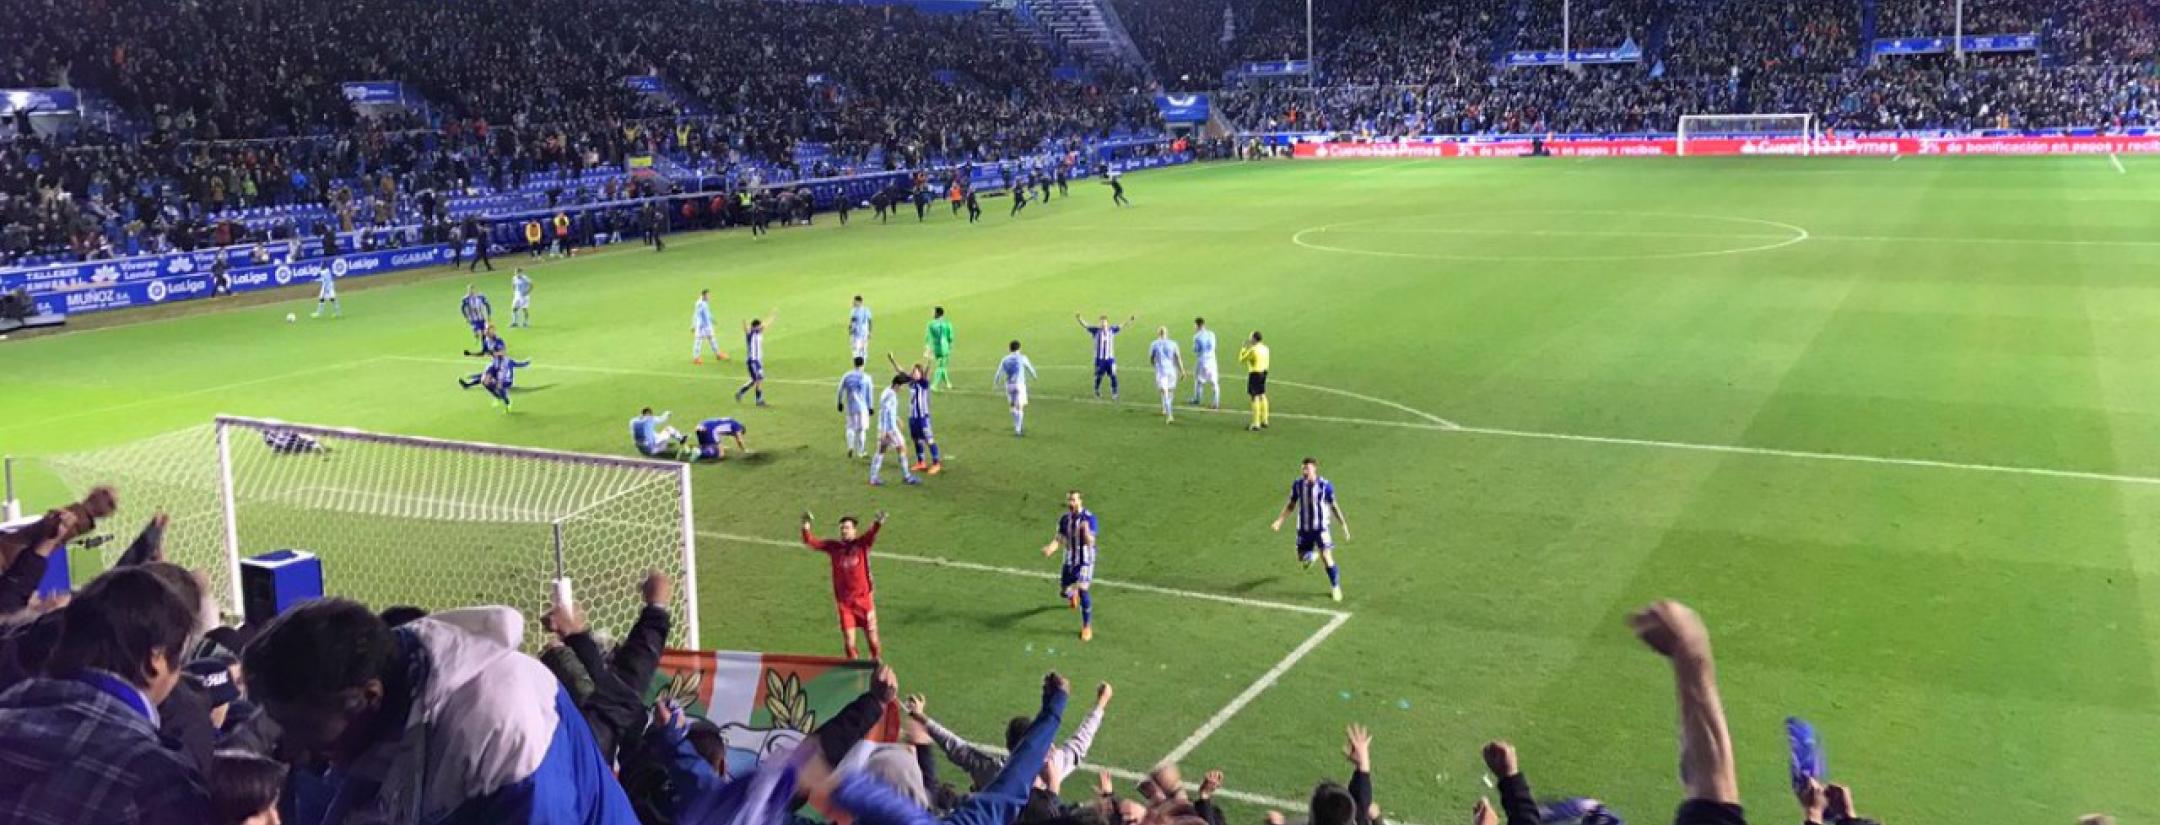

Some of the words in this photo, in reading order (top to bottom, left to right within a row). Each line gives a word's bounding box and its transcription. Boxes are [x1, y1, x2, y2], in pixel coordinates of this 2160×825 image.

[1846, 139, 1898, 155] Pymes
[1947, 141, 1961, 153] de
[349, 258, 379, 270] LaLiga
[232, 271, 268, 285] LaLiga
[168, 280, 206, 294] LaLiga
